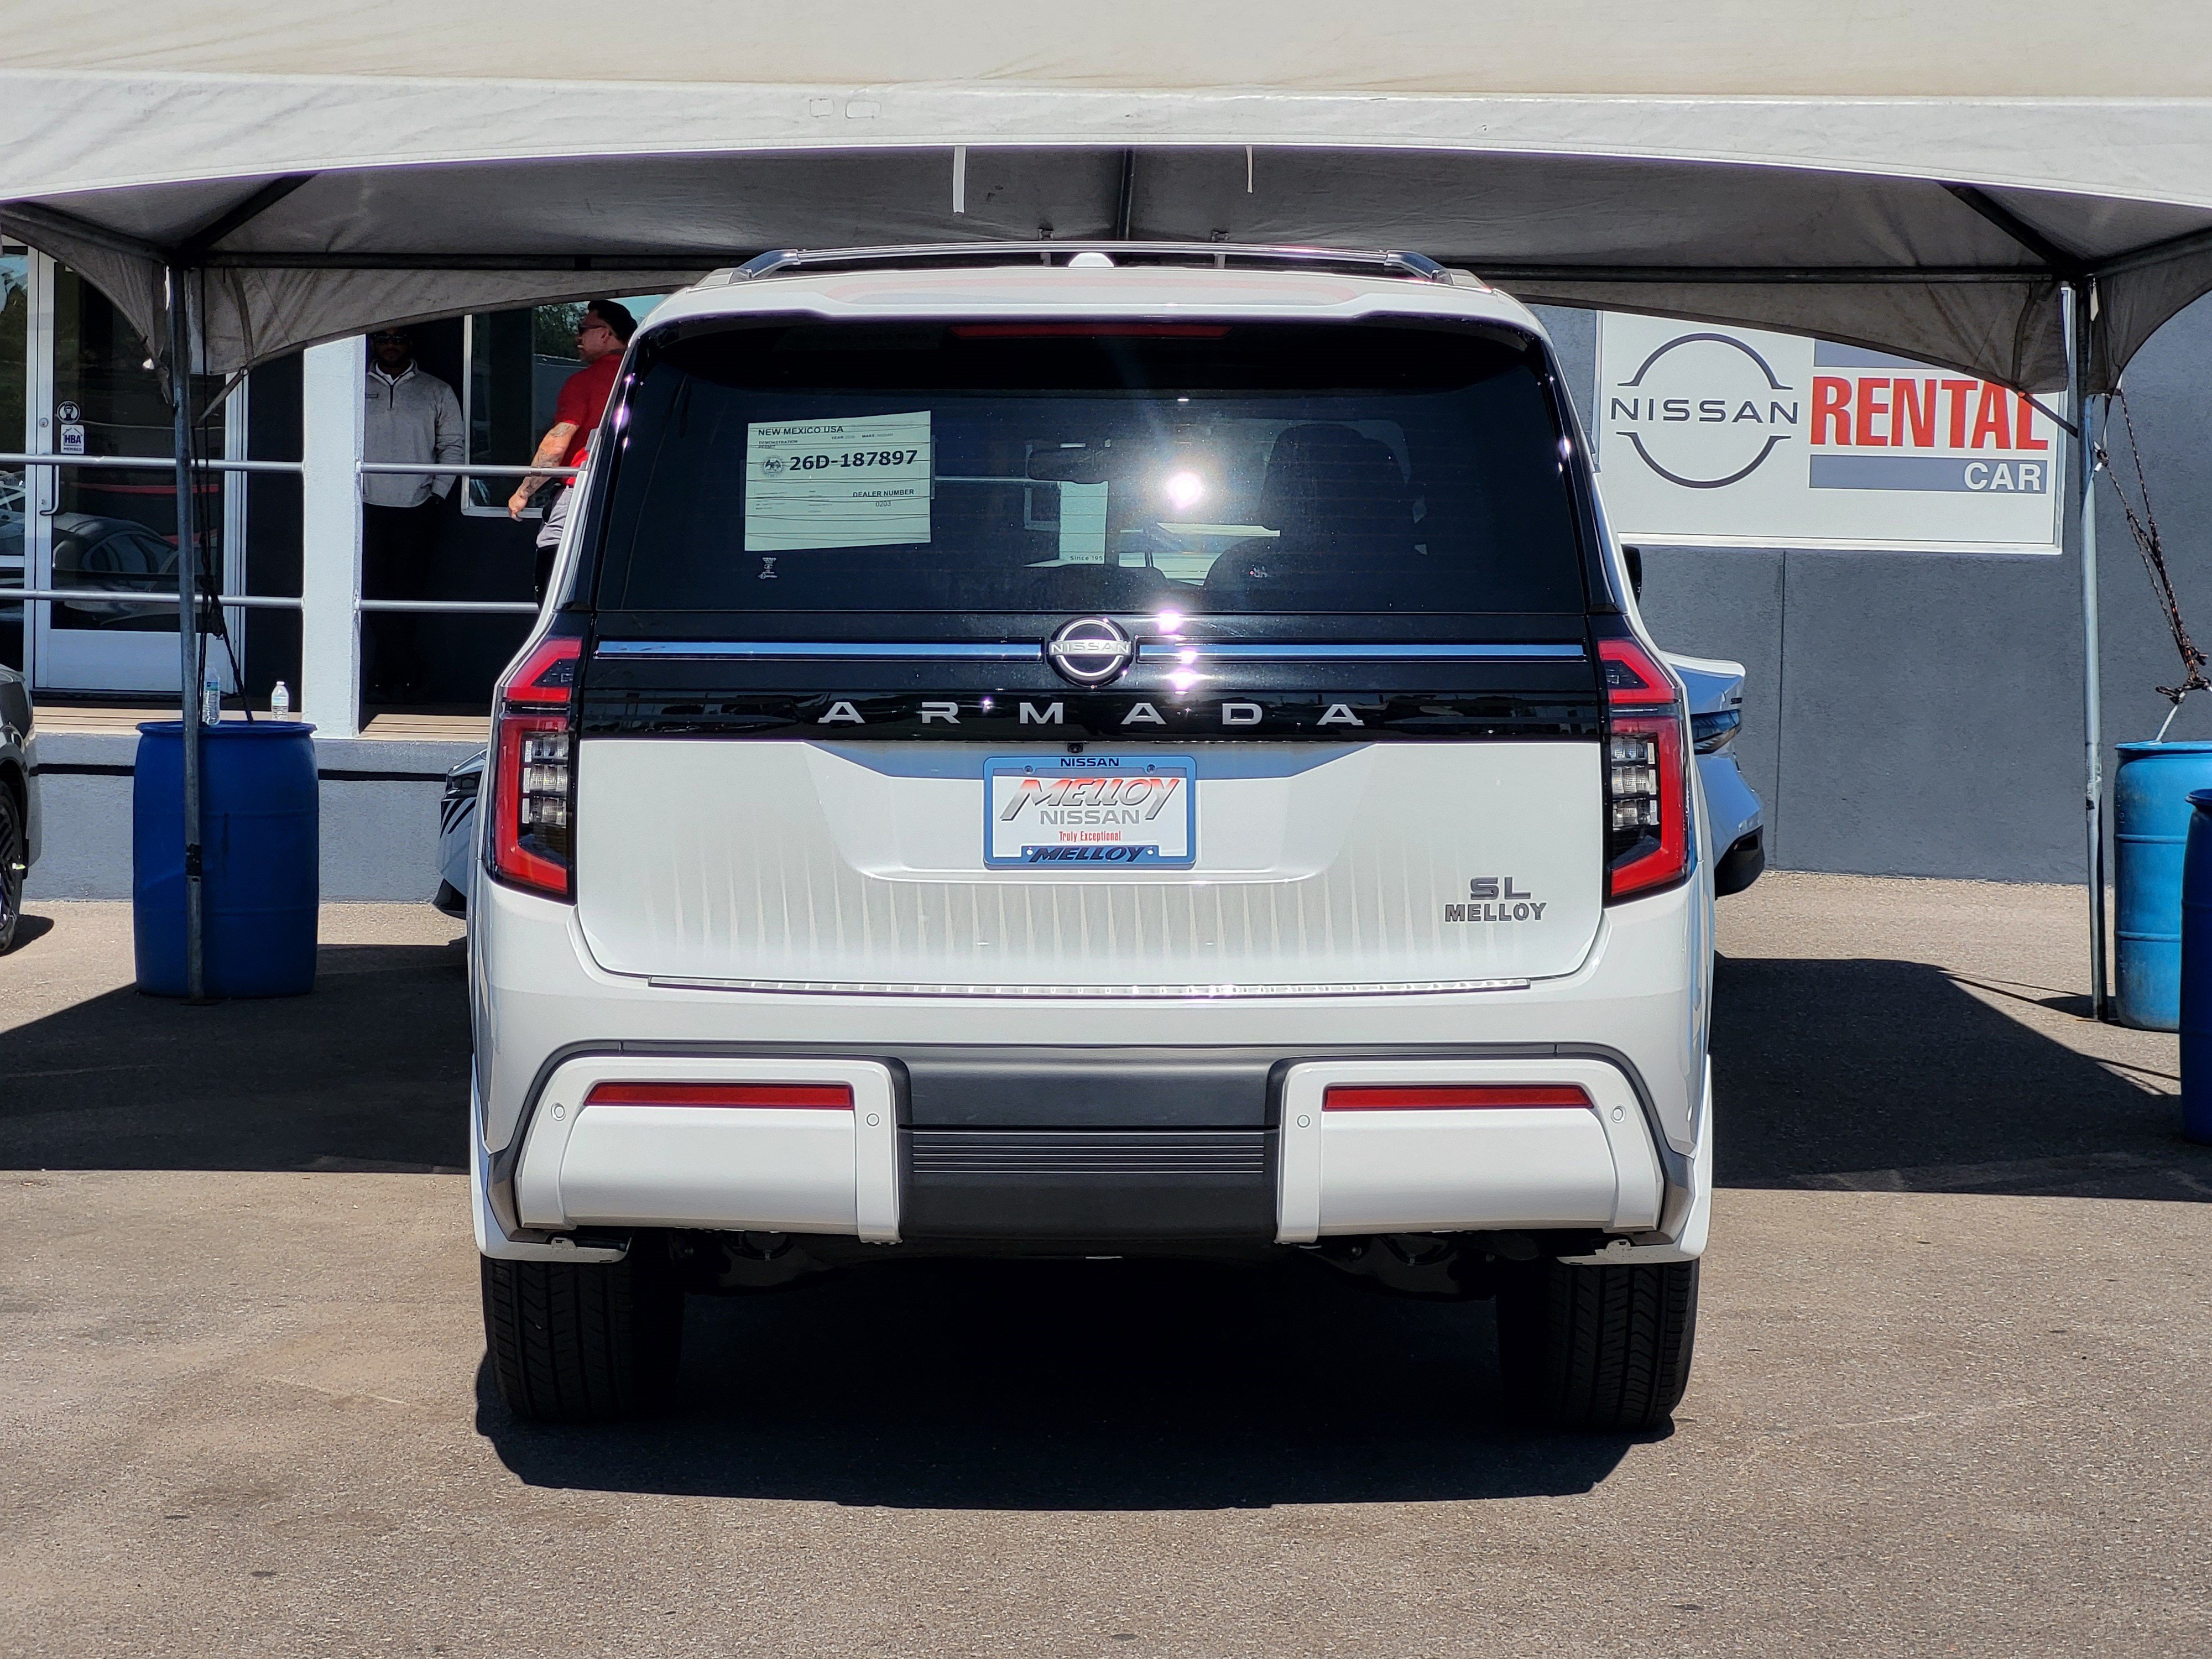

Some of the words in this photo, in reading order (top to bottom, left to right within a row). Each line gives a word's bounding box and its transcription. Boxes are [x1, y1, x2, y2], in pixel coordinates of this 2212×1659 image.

[1611, 398, 1798, 425] NISSAN
[1810, 376, 2049, 451] RENTAL
[65, 435, 81, 444] HBA
[789, 450, 917, 471] 26D-187897
[1964, 462, 2041, 491] CAR
[1052, 643, 1129, 654] NISSAN
[818, 701, 1365, 726] ARMADA
[1060, 758, 1119, 767] NISSAN
[1000, 778, 1180, 822] MELLOY
[1040, 810, 1140, 825] NISSAN
[1058, 831, 1078, 842] Truly
[1081, 831, 1121, 842] Exceptional
[1029, 846, 1145, 863] MELLOY
[1470, 877, 1531, 900] SL
[1445, 902, 1547, 922] MELLOY
